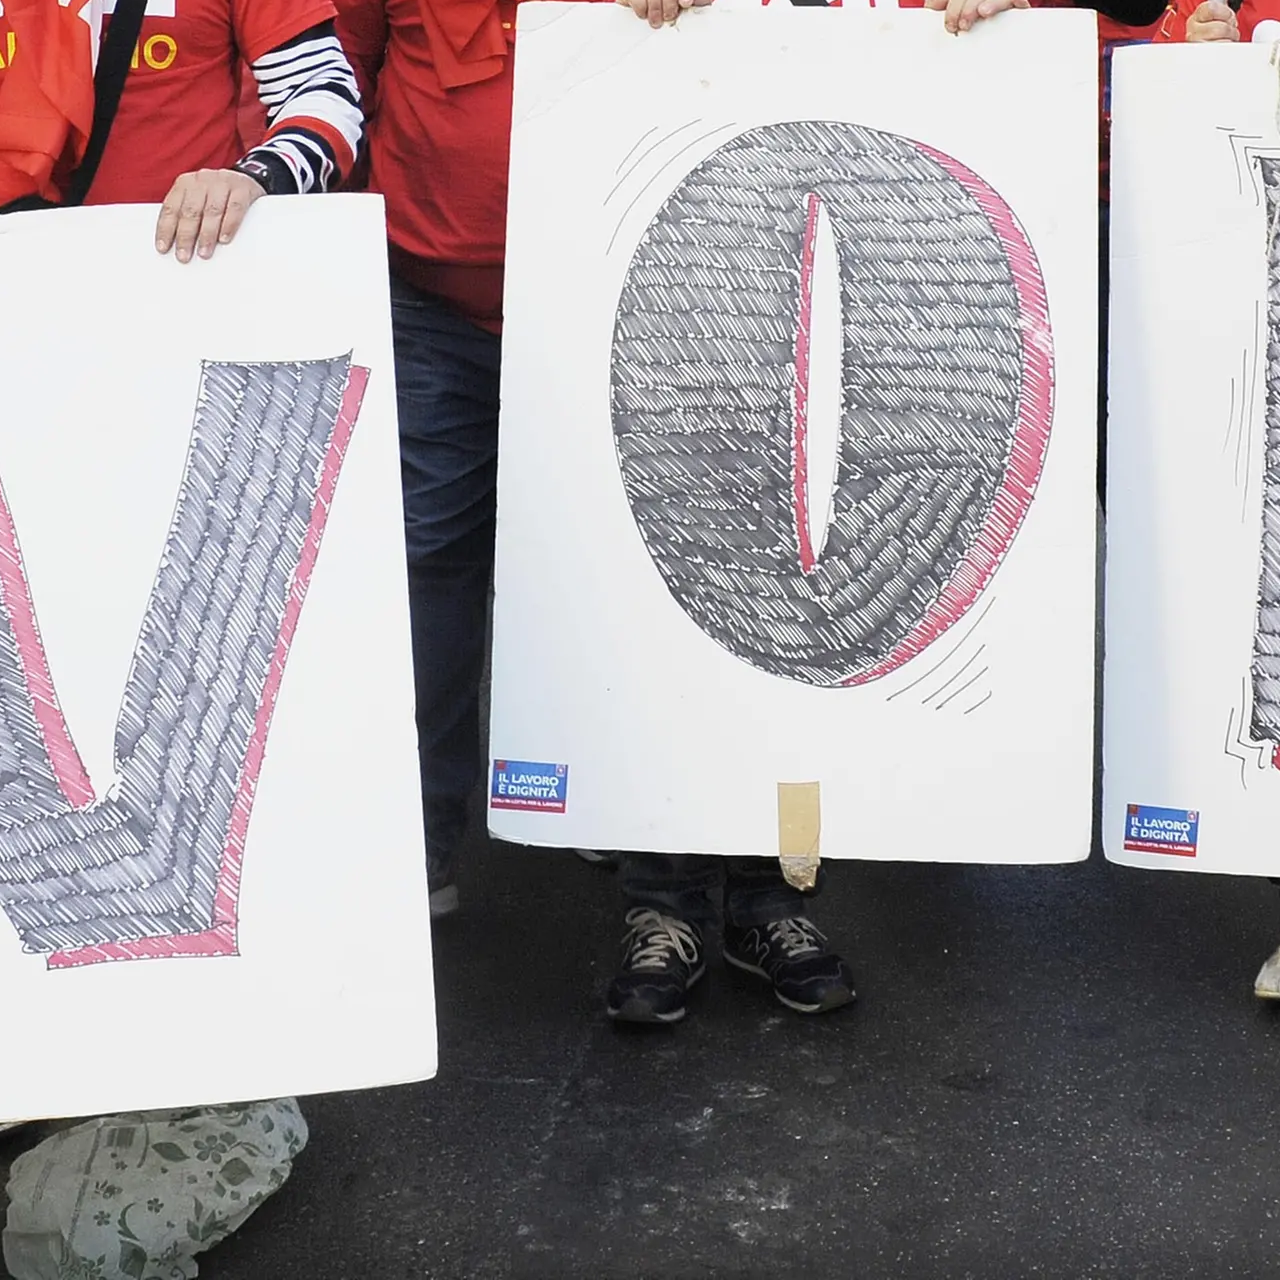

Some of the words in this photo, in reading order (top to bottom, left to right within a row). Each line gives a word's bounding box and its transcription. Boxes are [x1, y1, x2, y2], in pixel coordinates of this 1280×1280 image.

[611, 119, 1058, 689] O
[499, 773, 509, 783] IL
[512, 774, 559, 787] LAVORO
[498, 783, 506, 794] È
[508, 785, 558, 798] DIGNITÀ
[1131, 816, 1141, 827] IL
[1144, 818, 1191, 832] LAVORO
[1131, 826, 1138, 837] È
[1140, 828, 1190, 843] DIGNITÀ
